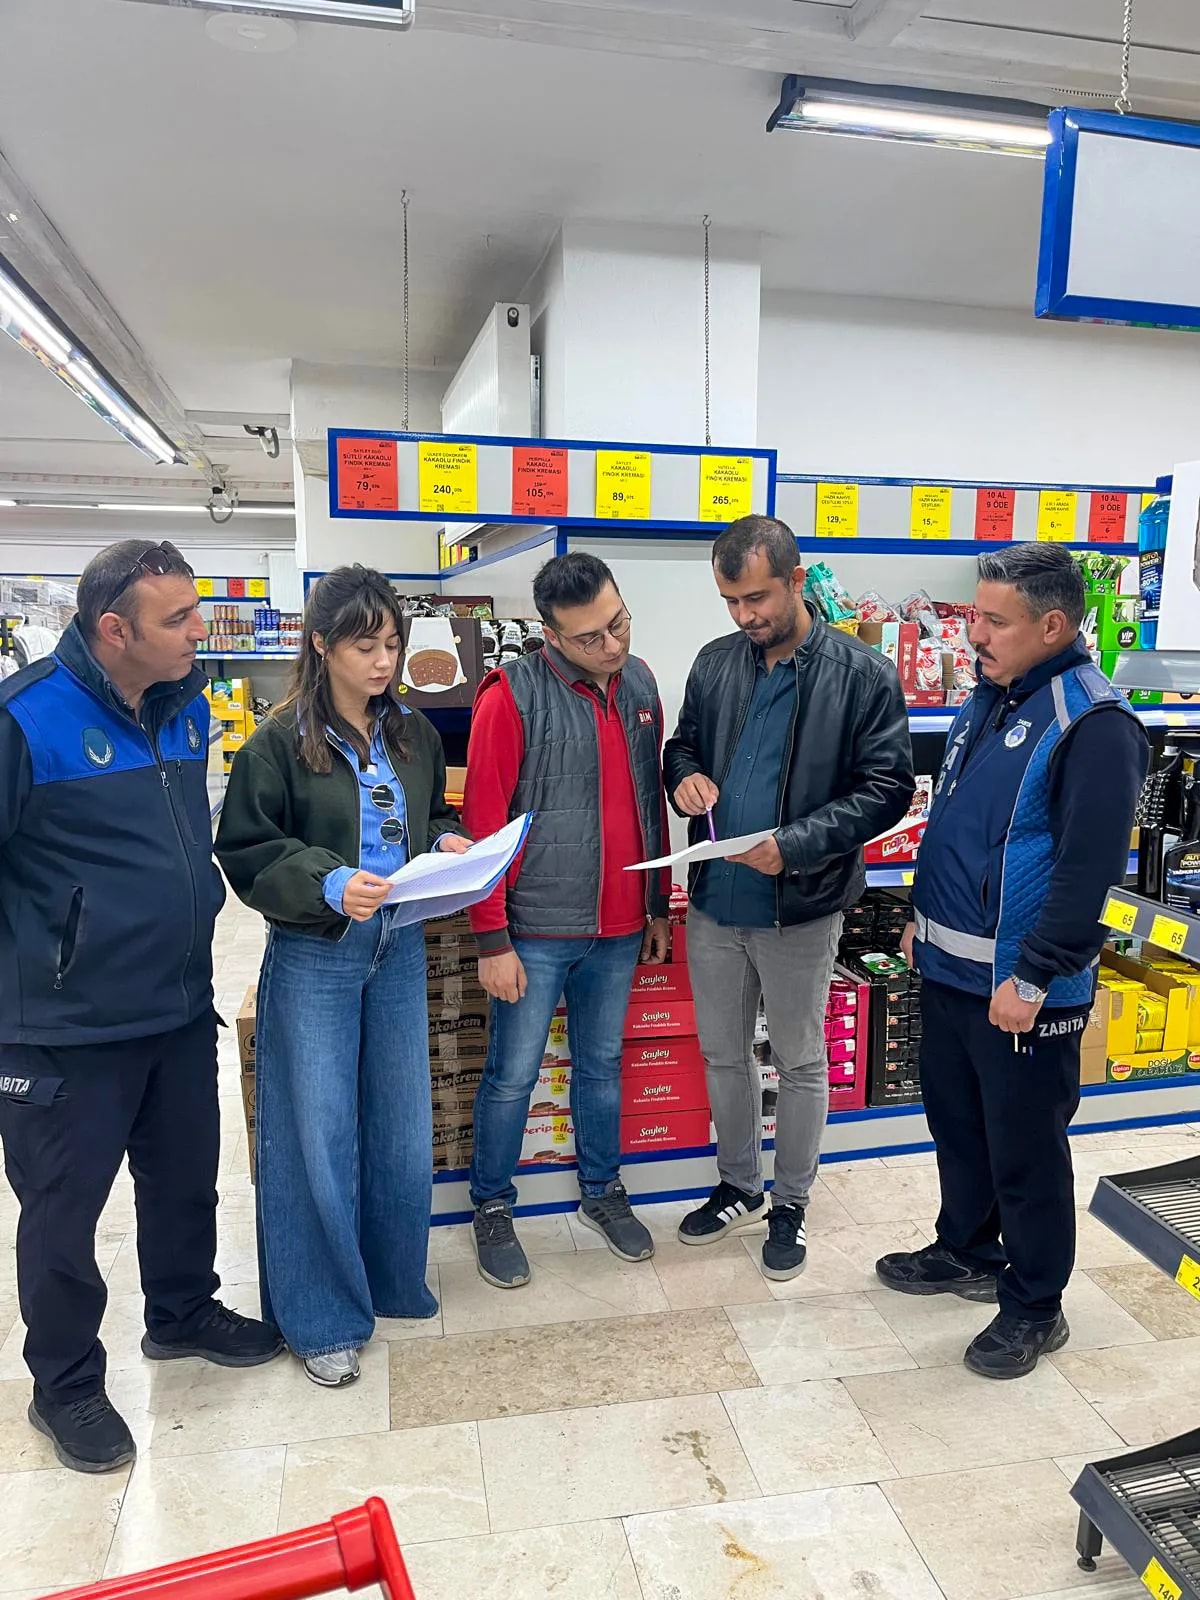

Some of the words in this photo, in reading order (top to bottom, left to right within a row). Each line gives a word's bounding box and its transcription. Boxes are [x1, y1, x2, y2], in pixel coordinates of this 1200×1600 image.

[363, 454, 392, 462] KAKAOLU
[987, 491, 996, 499] 10
[997, 491, 1007, 499] AL
[1101, 494, 1109, 502] 10
[993, 499, 1009, 509] ÖDE
[1106, 503, 1121, 512] ÖDE
[1122, 913, 1134, 926] 65
[1171, 932, 1183, 945] 65
[639, 973, 668, 986] Sayley
[641, 1011, 670, 1022] Sayley
[429, 1018, 481, 1034] okokrem
[1038, 1016, 1084, 1038] ZABITA
[641, 1049, 670, 1061] Sayley
[0, 1076, 31, 1093] ABITA
[431, 1073, 482, 1089] okokrem
[643, 1084, 672, 1096] Sayley
[639, 1125, 668, 1137] Sayley
